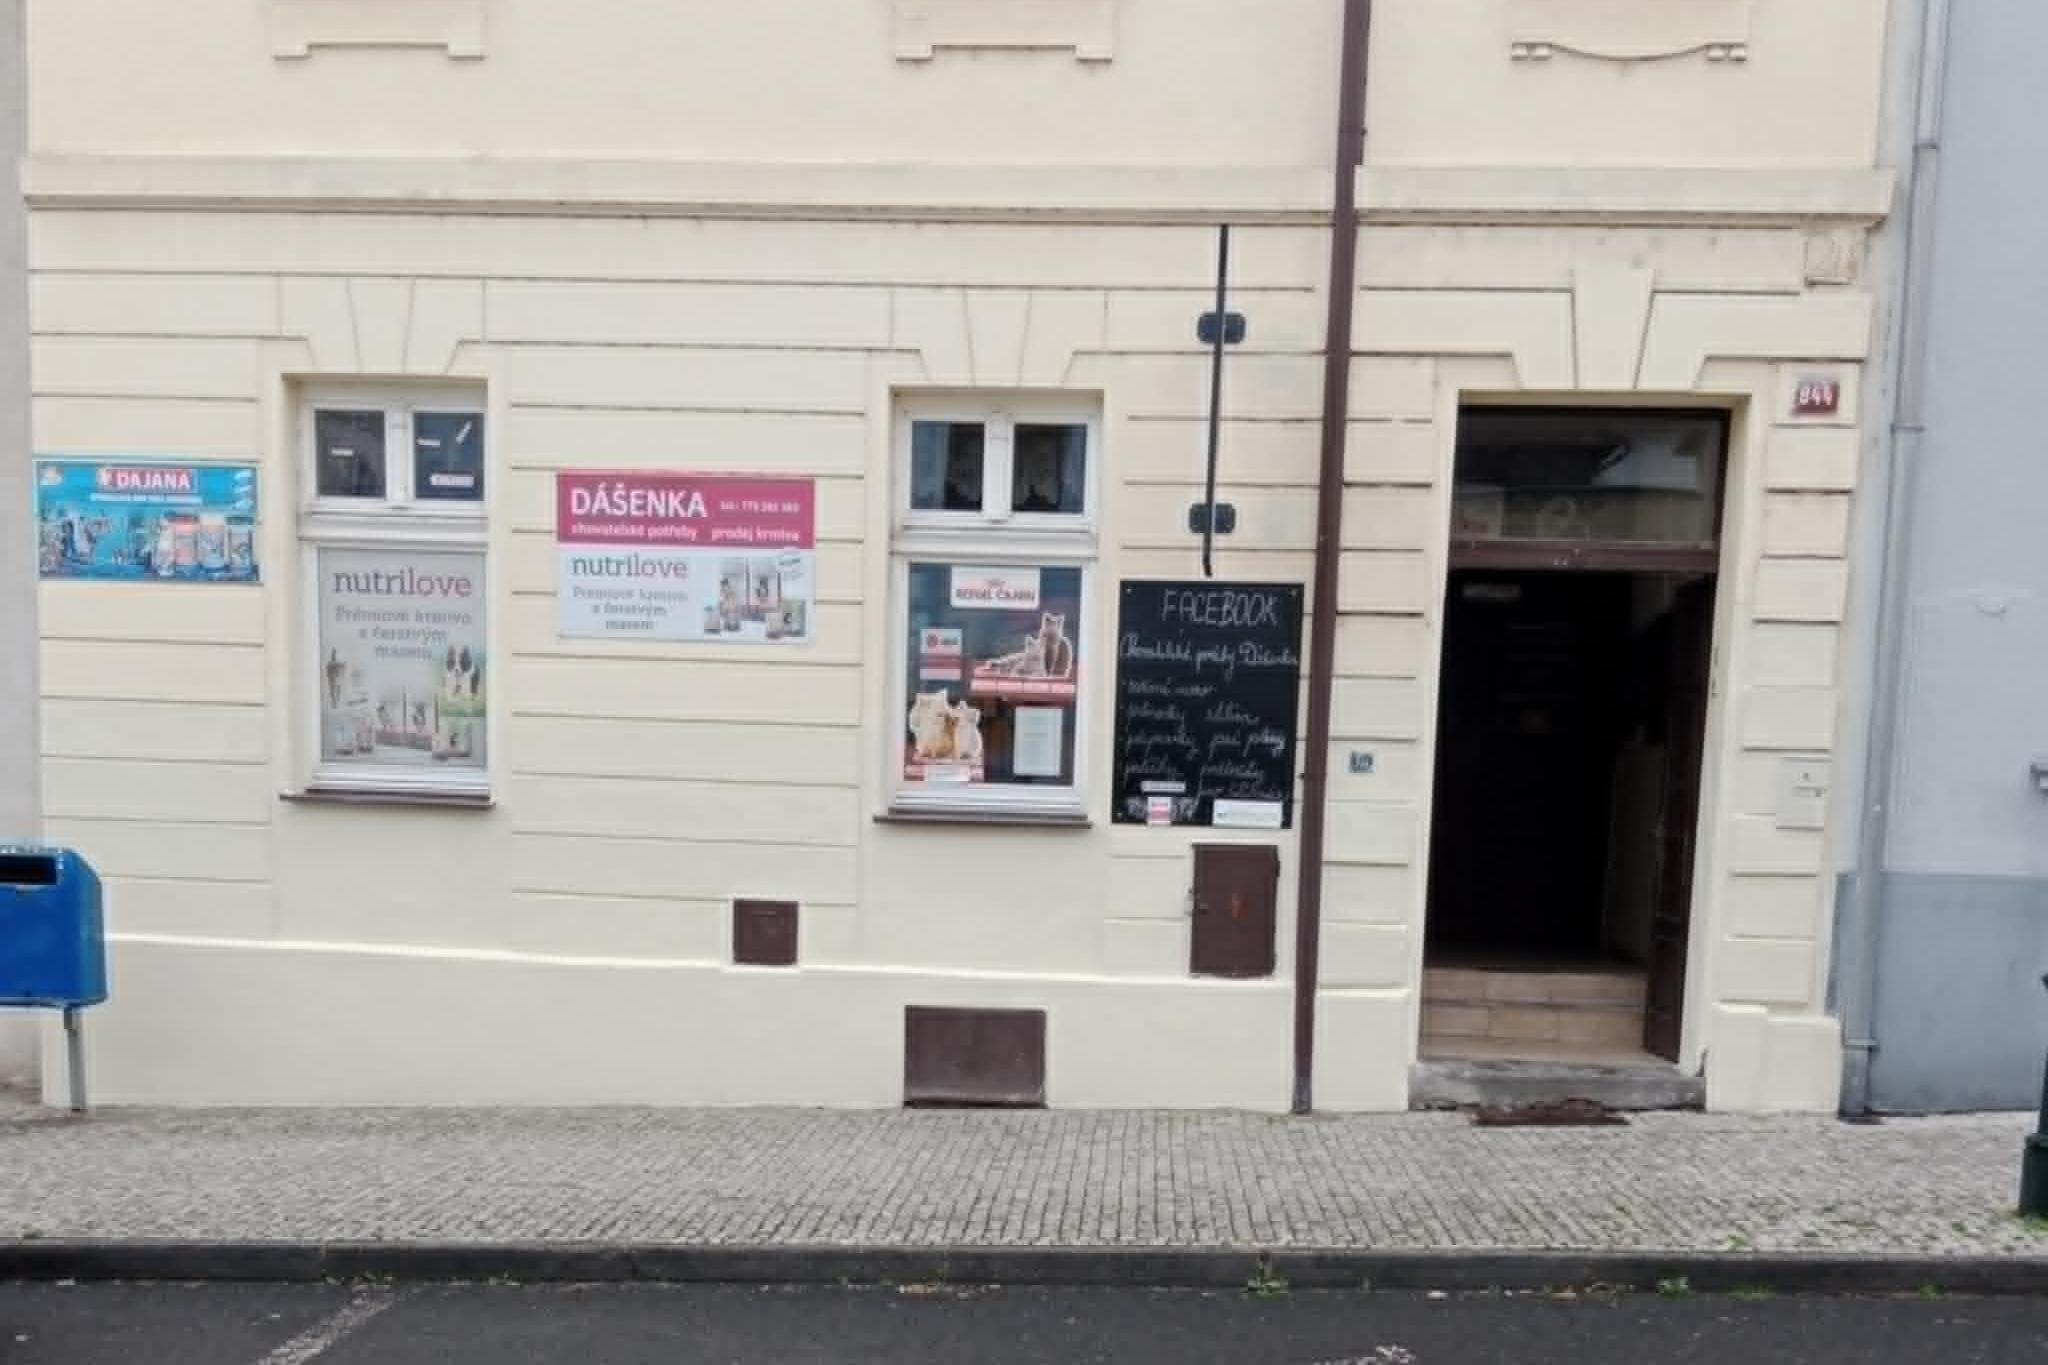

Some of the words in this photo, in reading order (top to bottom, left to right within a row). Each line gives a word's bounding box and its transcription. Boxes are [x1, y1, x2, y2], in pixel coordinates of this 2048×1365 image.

[116, 471, 191, 490] DAJANA
[571, 482, 709, 519] DÁŠENKA
[647, 525, 697, 541] potřeby
[711, 525, 753, 542] prodej
[572, 554, 688, 579] nutrilove
[333, 566, 473, 598] nutrilove
[1161, 588, 1278, 627] FACEBOOK
